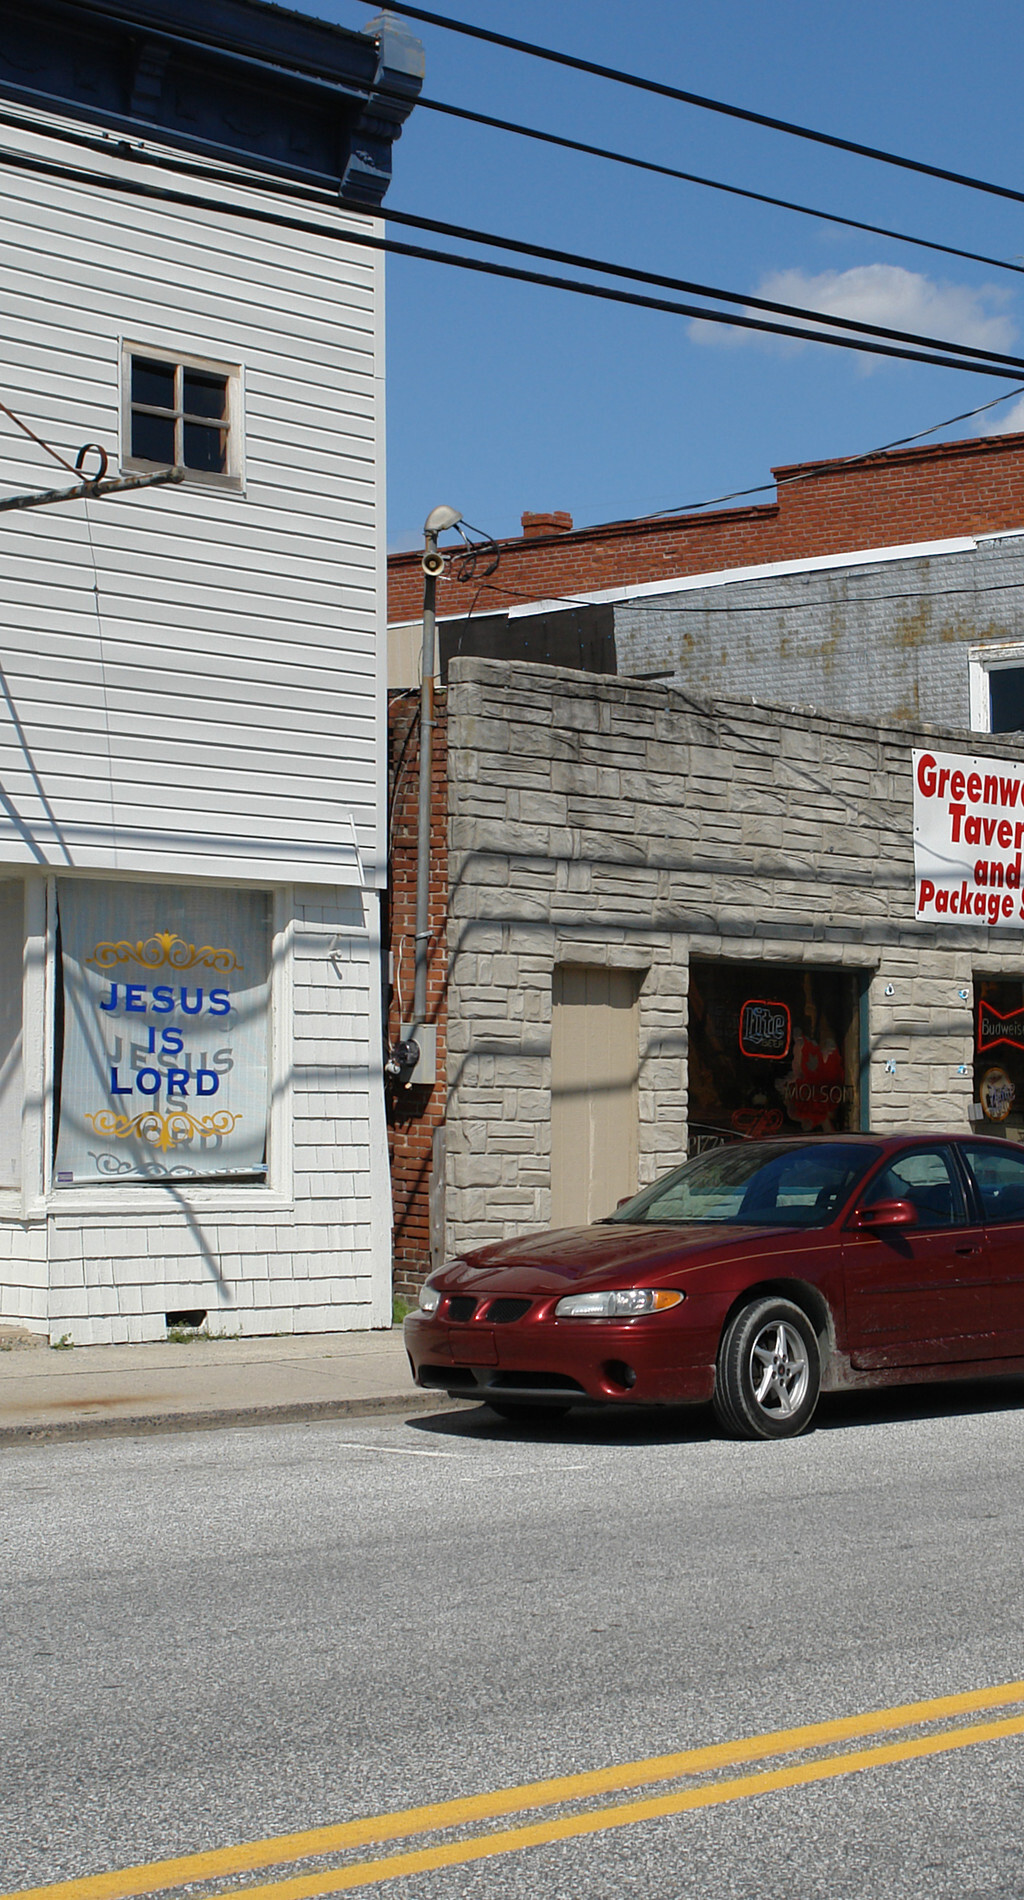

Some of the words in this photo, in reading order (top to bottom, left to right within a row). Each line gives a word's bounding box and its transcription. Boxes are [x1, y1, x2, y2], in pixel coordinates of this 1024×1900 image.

[974, 851, 1023, 890] and
[918, 879, 1014, 926] Package
[99, 982, 232, 1017] JESUS
[148, 1025, 185, 1056] IS
[743, 1006, 785, 1045] Lite
[110, 1066, 220, 1097] LORD
[784, 1082, 855, 1105] MOLSON
